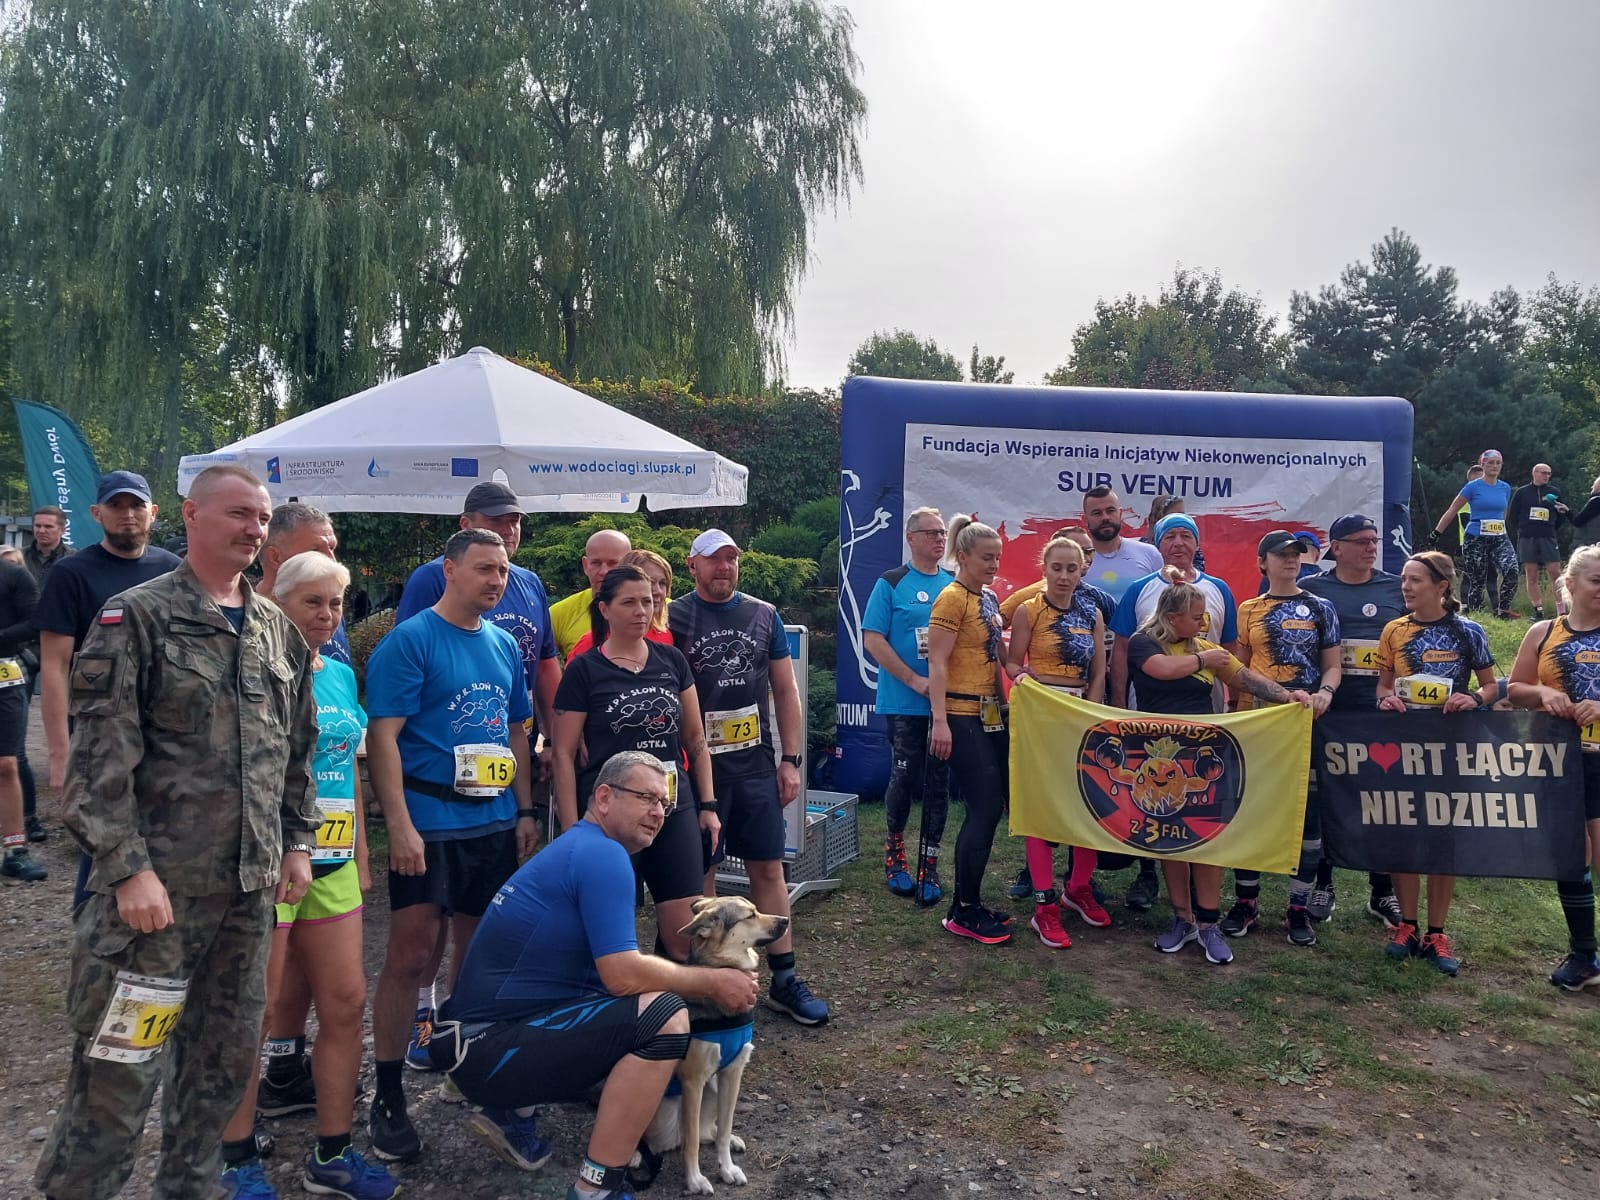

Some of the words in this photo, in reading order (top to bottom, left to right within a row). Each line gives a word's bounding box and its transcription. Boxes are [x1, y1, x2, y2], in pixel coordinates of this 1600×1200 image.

[922, 436, 1000, 456] Fundacja
[1005, 440, 1099, 459] Wspierania
[1105, 445, 1180, 464] Inicjatyw
[1185, 449, 1367, 468] Niekonwencjonalnych
[285, 460, 345, 470] INFRASTRUKTURA
[528, 460, 696, 477] www.wodociagi.slupsk.pl
[1057, 470, 1113, 493] SUB
[1121, 473, 1232, 498] VENTUM
[518, 615, 538, 634] TEAM
[736, 630, 758, 647] TEAM
[718, 678, 746, 687] USTKA
[1417, 686, 1439, 700] 44
[731, 721, 751, 739] 73
[1117, 721, 1218, 743] ANANASY
[636, 740, 667, 750] USTKA
[487, 762, 508, 781] 15
[1456, 742, 1567, 782] ŁĄCZY
[317, 771, 345, 781] USTKA
[1360, 791, 1418, 826] NIE
[1425, 792, 1538, 829] DZIELI
[325, 819, 347, 841] 77
[1144, 817, 1160, 844] 3
[1161, 824, 1189, 840] FAL
